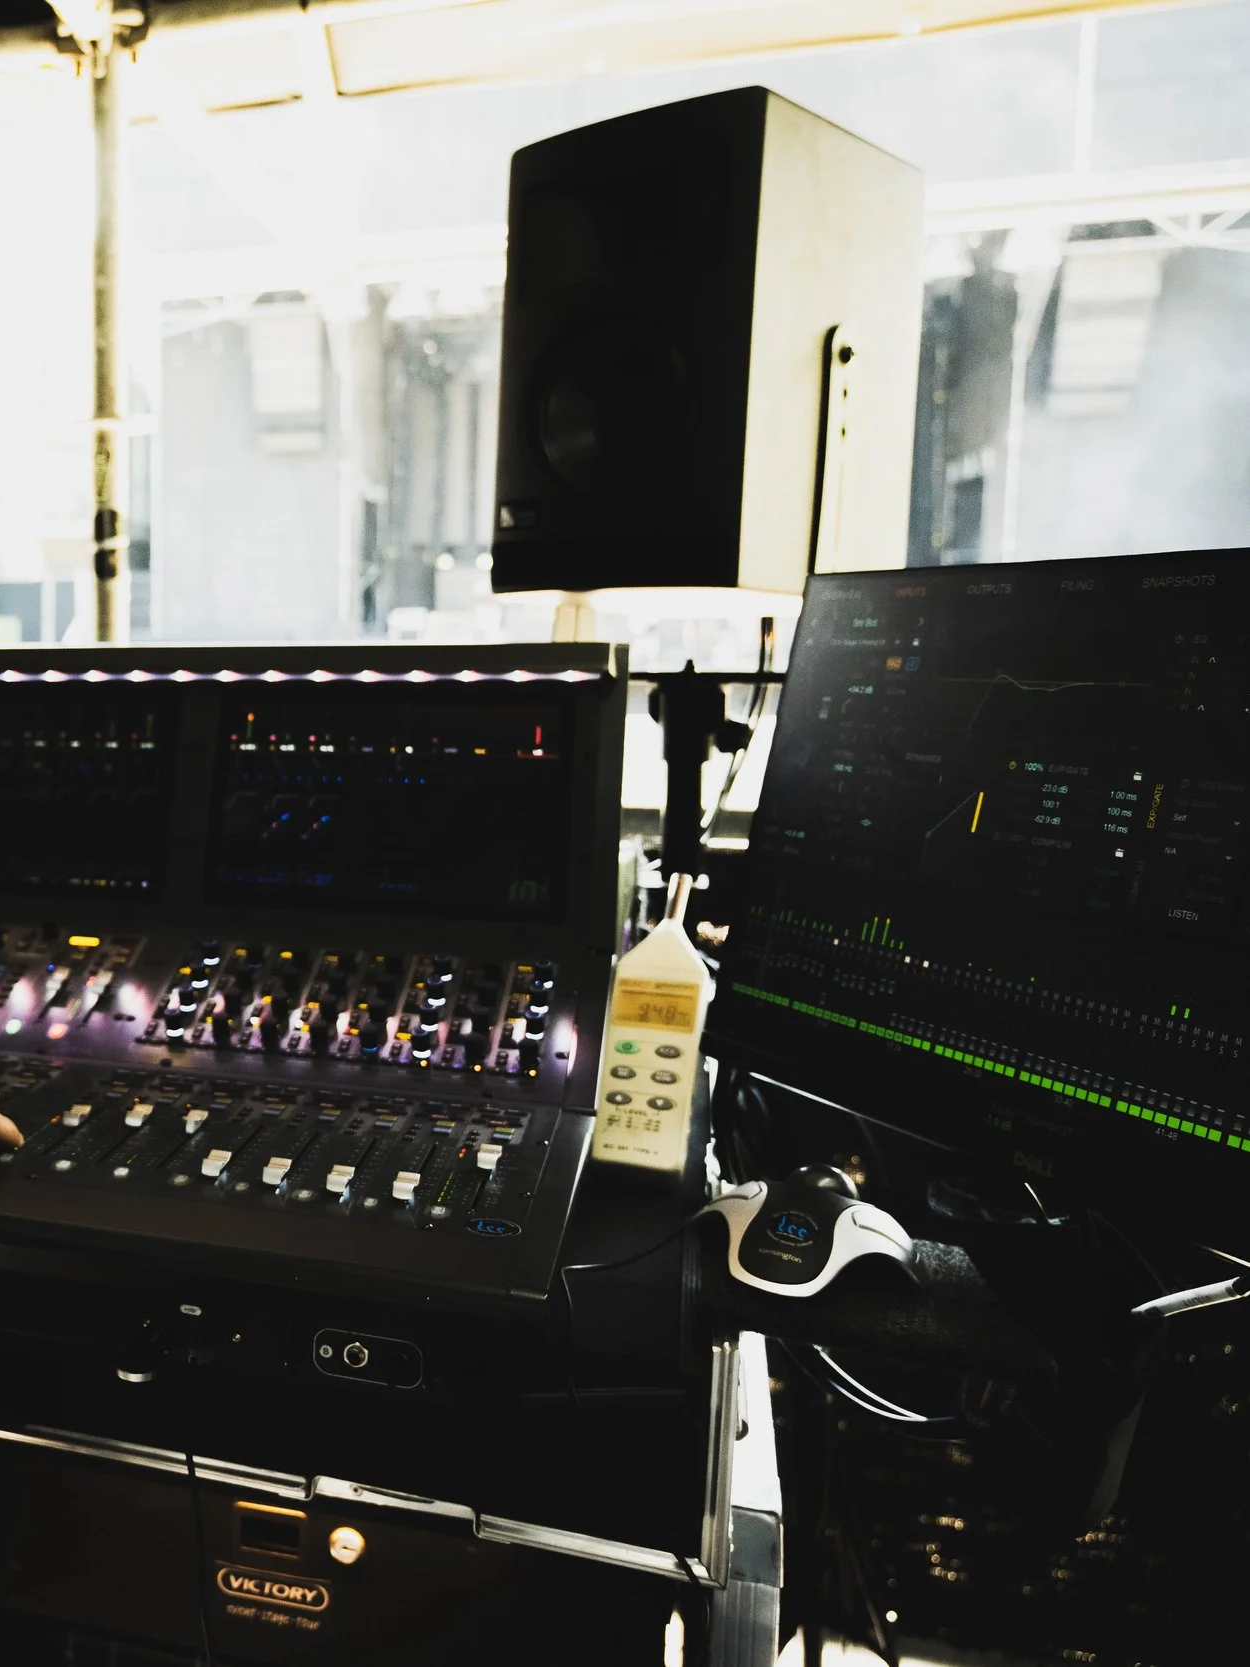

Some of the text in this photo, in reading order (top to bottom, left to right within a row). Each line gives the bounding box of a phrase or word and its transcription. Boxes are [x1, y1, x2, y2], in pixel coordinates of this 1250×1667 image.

[967, 583, 1012, 596] OUTPUTS
[1060, 580, 1095, 592] FILING
[1141, 574, 1216, 590] SNAPSHOTS
[1146, 783, 1165, 830] EXP/GATE
[1168, 907, 1200, 921] LISTEN
[1154, 1127, 1179, 1141] 41-48
[1012, 1149, 1056, 1179] DELL
[228, 1573, 319, 1604] VICTORY
